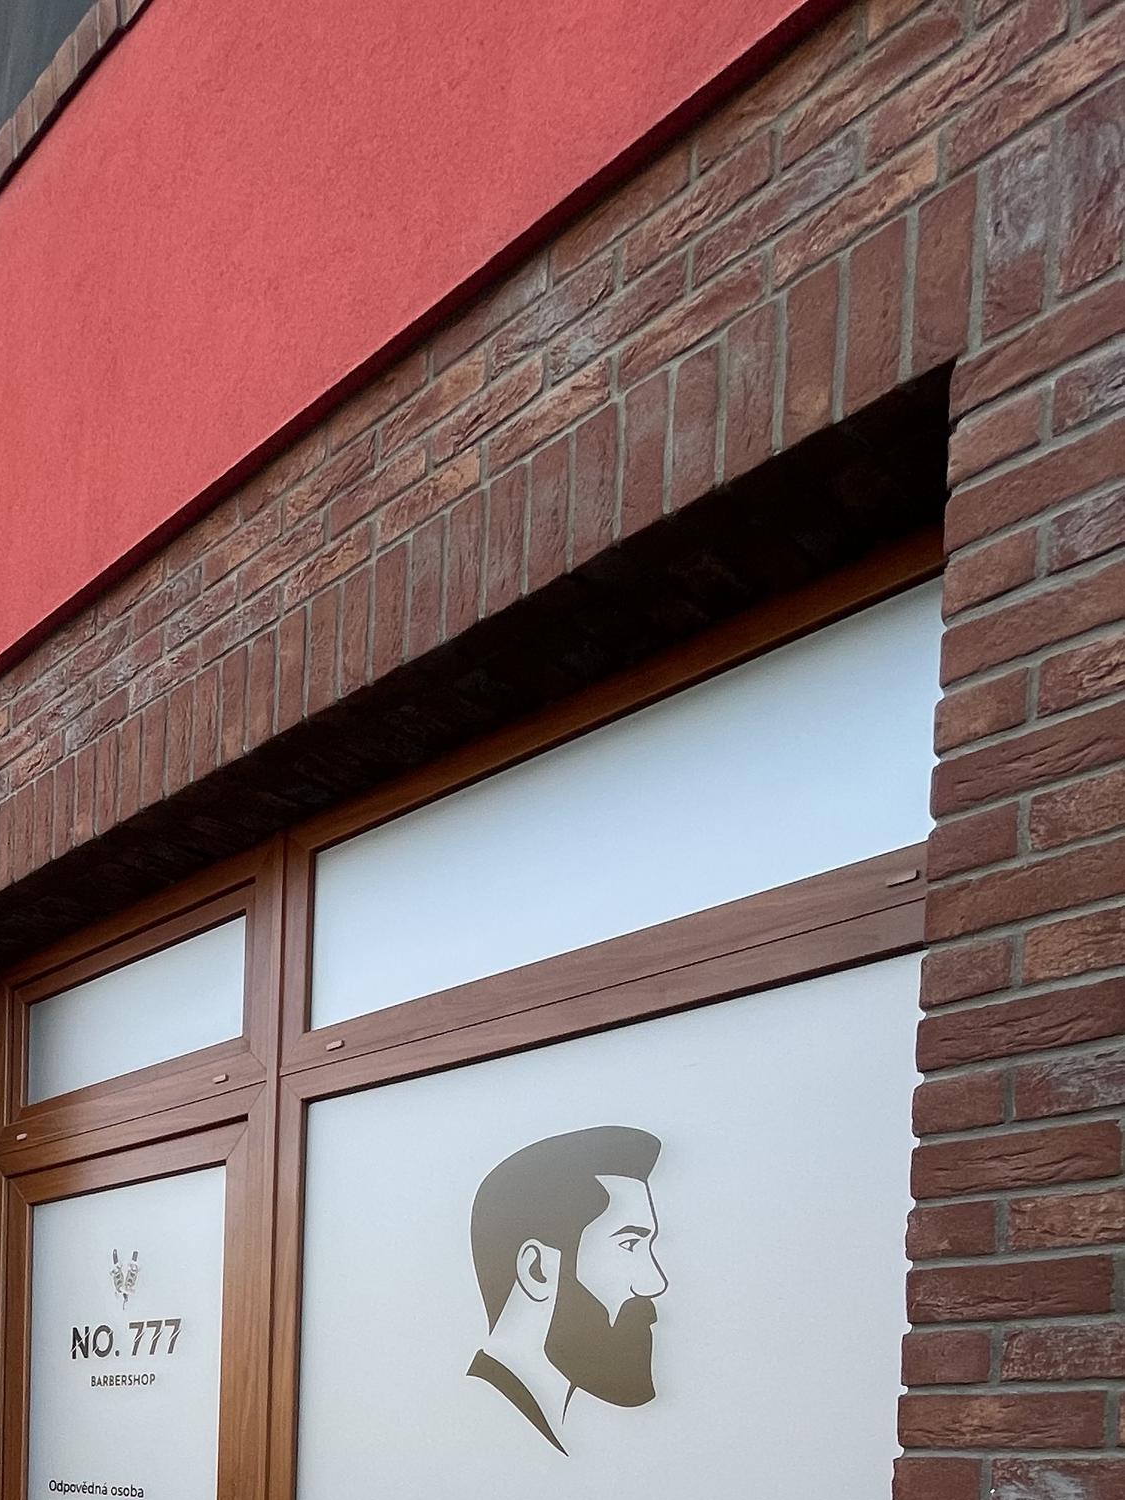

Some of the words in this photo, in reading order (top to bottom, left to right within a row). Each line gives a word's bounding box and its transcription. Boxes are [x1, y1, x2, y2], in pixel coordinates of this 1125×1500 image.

[71, 1325, 120, 1360] NO.
[129, 1318, 182, 1356] 777
[90, 1373, 156, 1387] BARBERSHOP
[48, 1479, 108, 1496] Odpovědná
[111, 1484, 145, 1498] osoba
